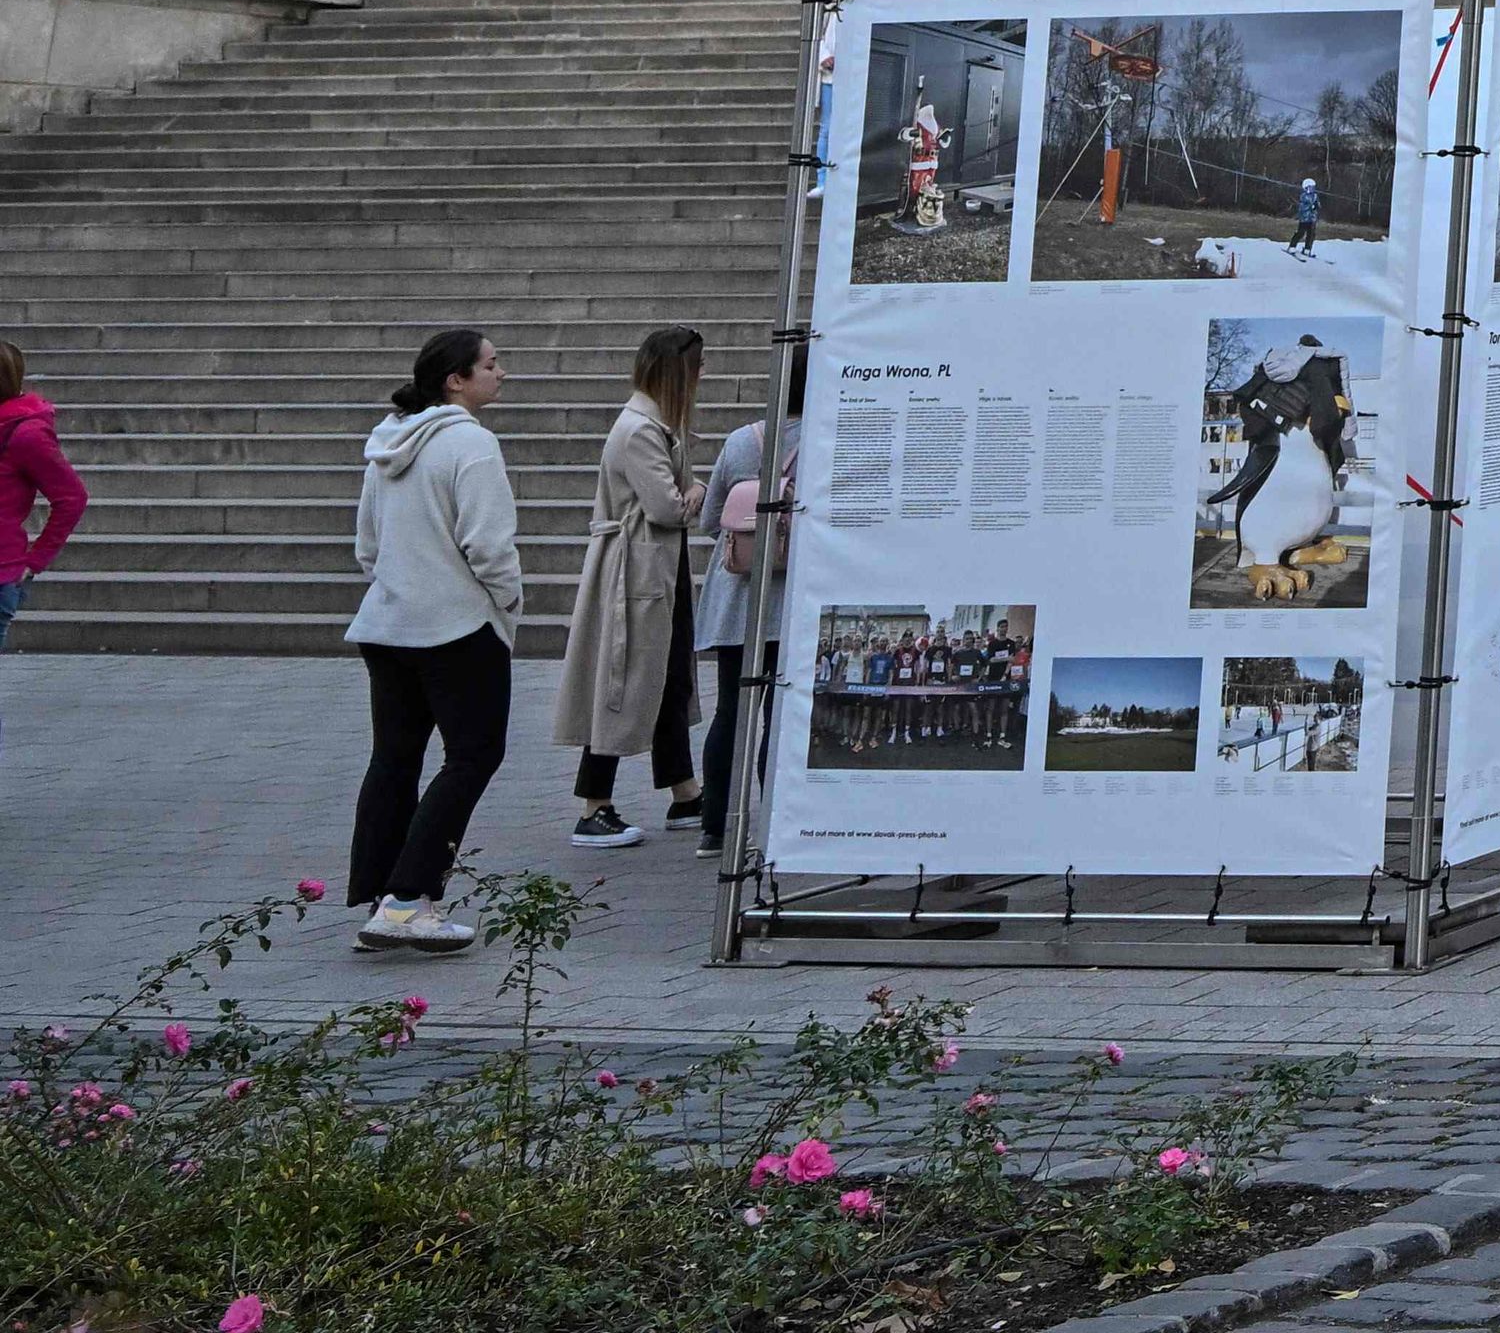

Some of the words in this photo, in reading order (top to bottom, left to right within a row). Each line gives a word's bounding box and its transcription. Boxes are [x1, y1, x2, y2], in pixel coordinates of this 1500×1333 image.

[841, 364, 882, 382] Kinga
[885, 364, 933, 379] Wrona,
[937, 364, 952, 378] PL
